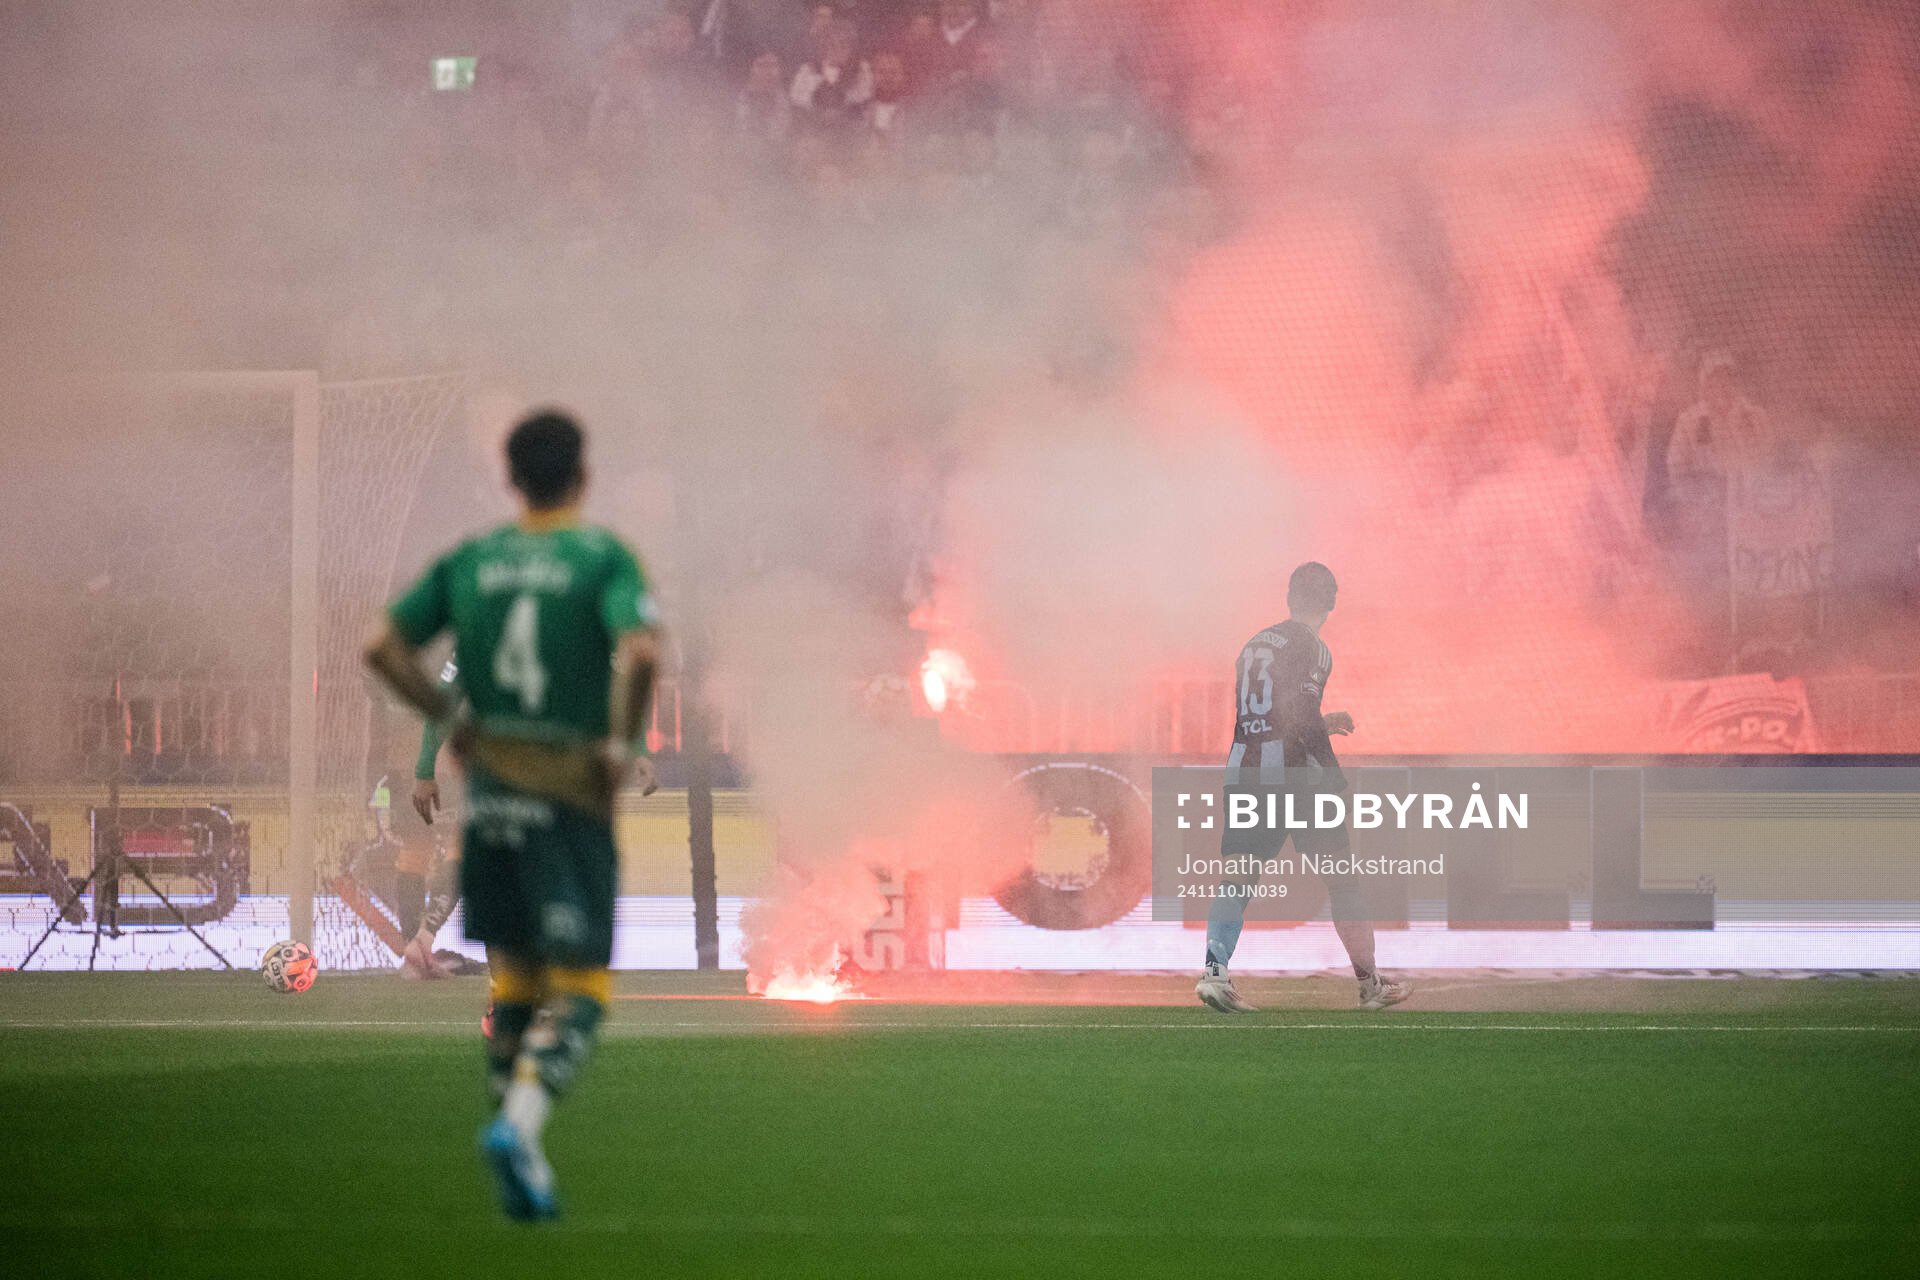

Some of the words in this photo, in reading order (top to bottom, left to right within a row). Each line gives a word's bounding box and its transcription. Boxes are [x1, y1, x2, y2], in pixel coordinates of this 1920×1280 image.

[493, 594, 548, 713] 4
[1240, 647, 1274, 715] 13
[1242, 719, 1273, 736] TCL
